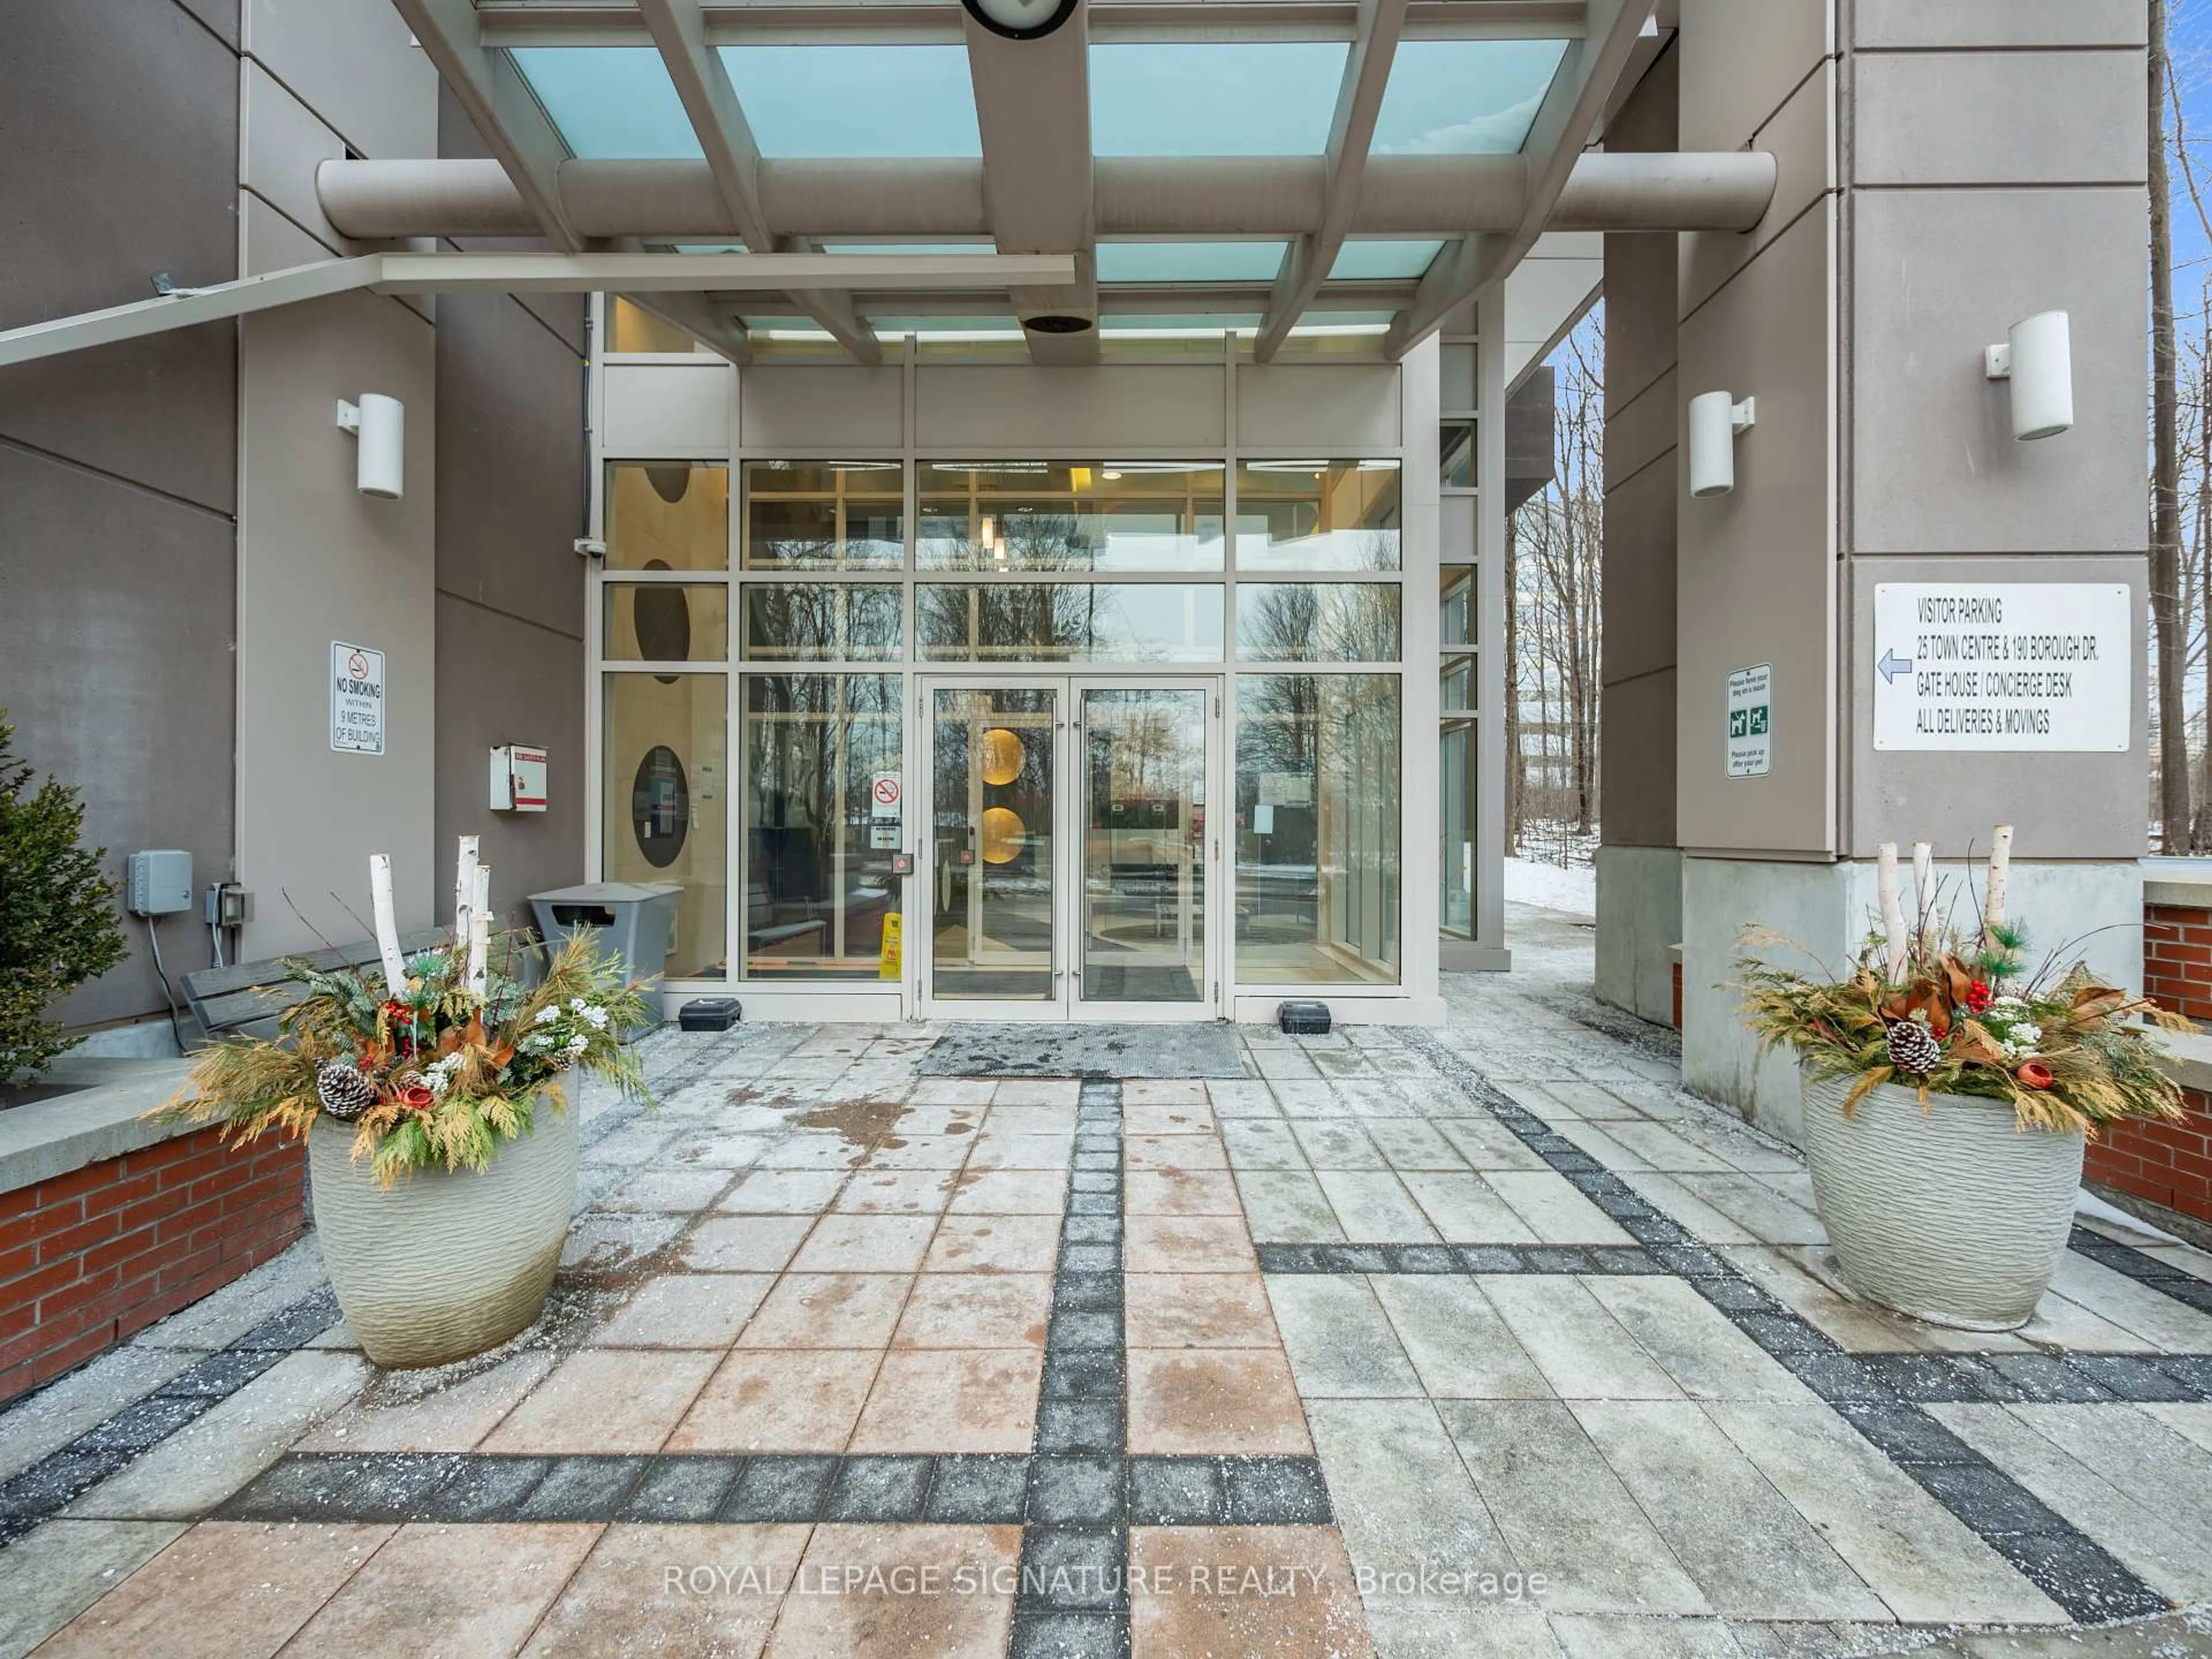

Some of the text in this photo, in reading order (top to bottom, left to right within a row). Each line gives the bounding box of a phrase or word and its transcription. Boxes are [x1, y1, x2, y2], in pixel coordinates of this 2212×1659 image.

[1918, 597, 2002, 623] VISITOR PARKING
[1917, 635, 2099, 661] 25 TOWN CENTRE & 190 BOROUGH DR.
[337, 676, 380, 699] NO SMOKING
[1917, 672, 1942, 696] GATE
[1945, 672, 1977, 696] HOUSE
[1986, 672, 2043, 697] CONCIERGE
[2046, 672, 2072, 697] DESK
[346, 699, 372, 709] WITHIN
[347, 710, 376, 727] METRES
[1916, 709, 2049, 734] ALL DELIVERIES & MOVINGS
[336, 726, 380, 743] OF BUILDING
